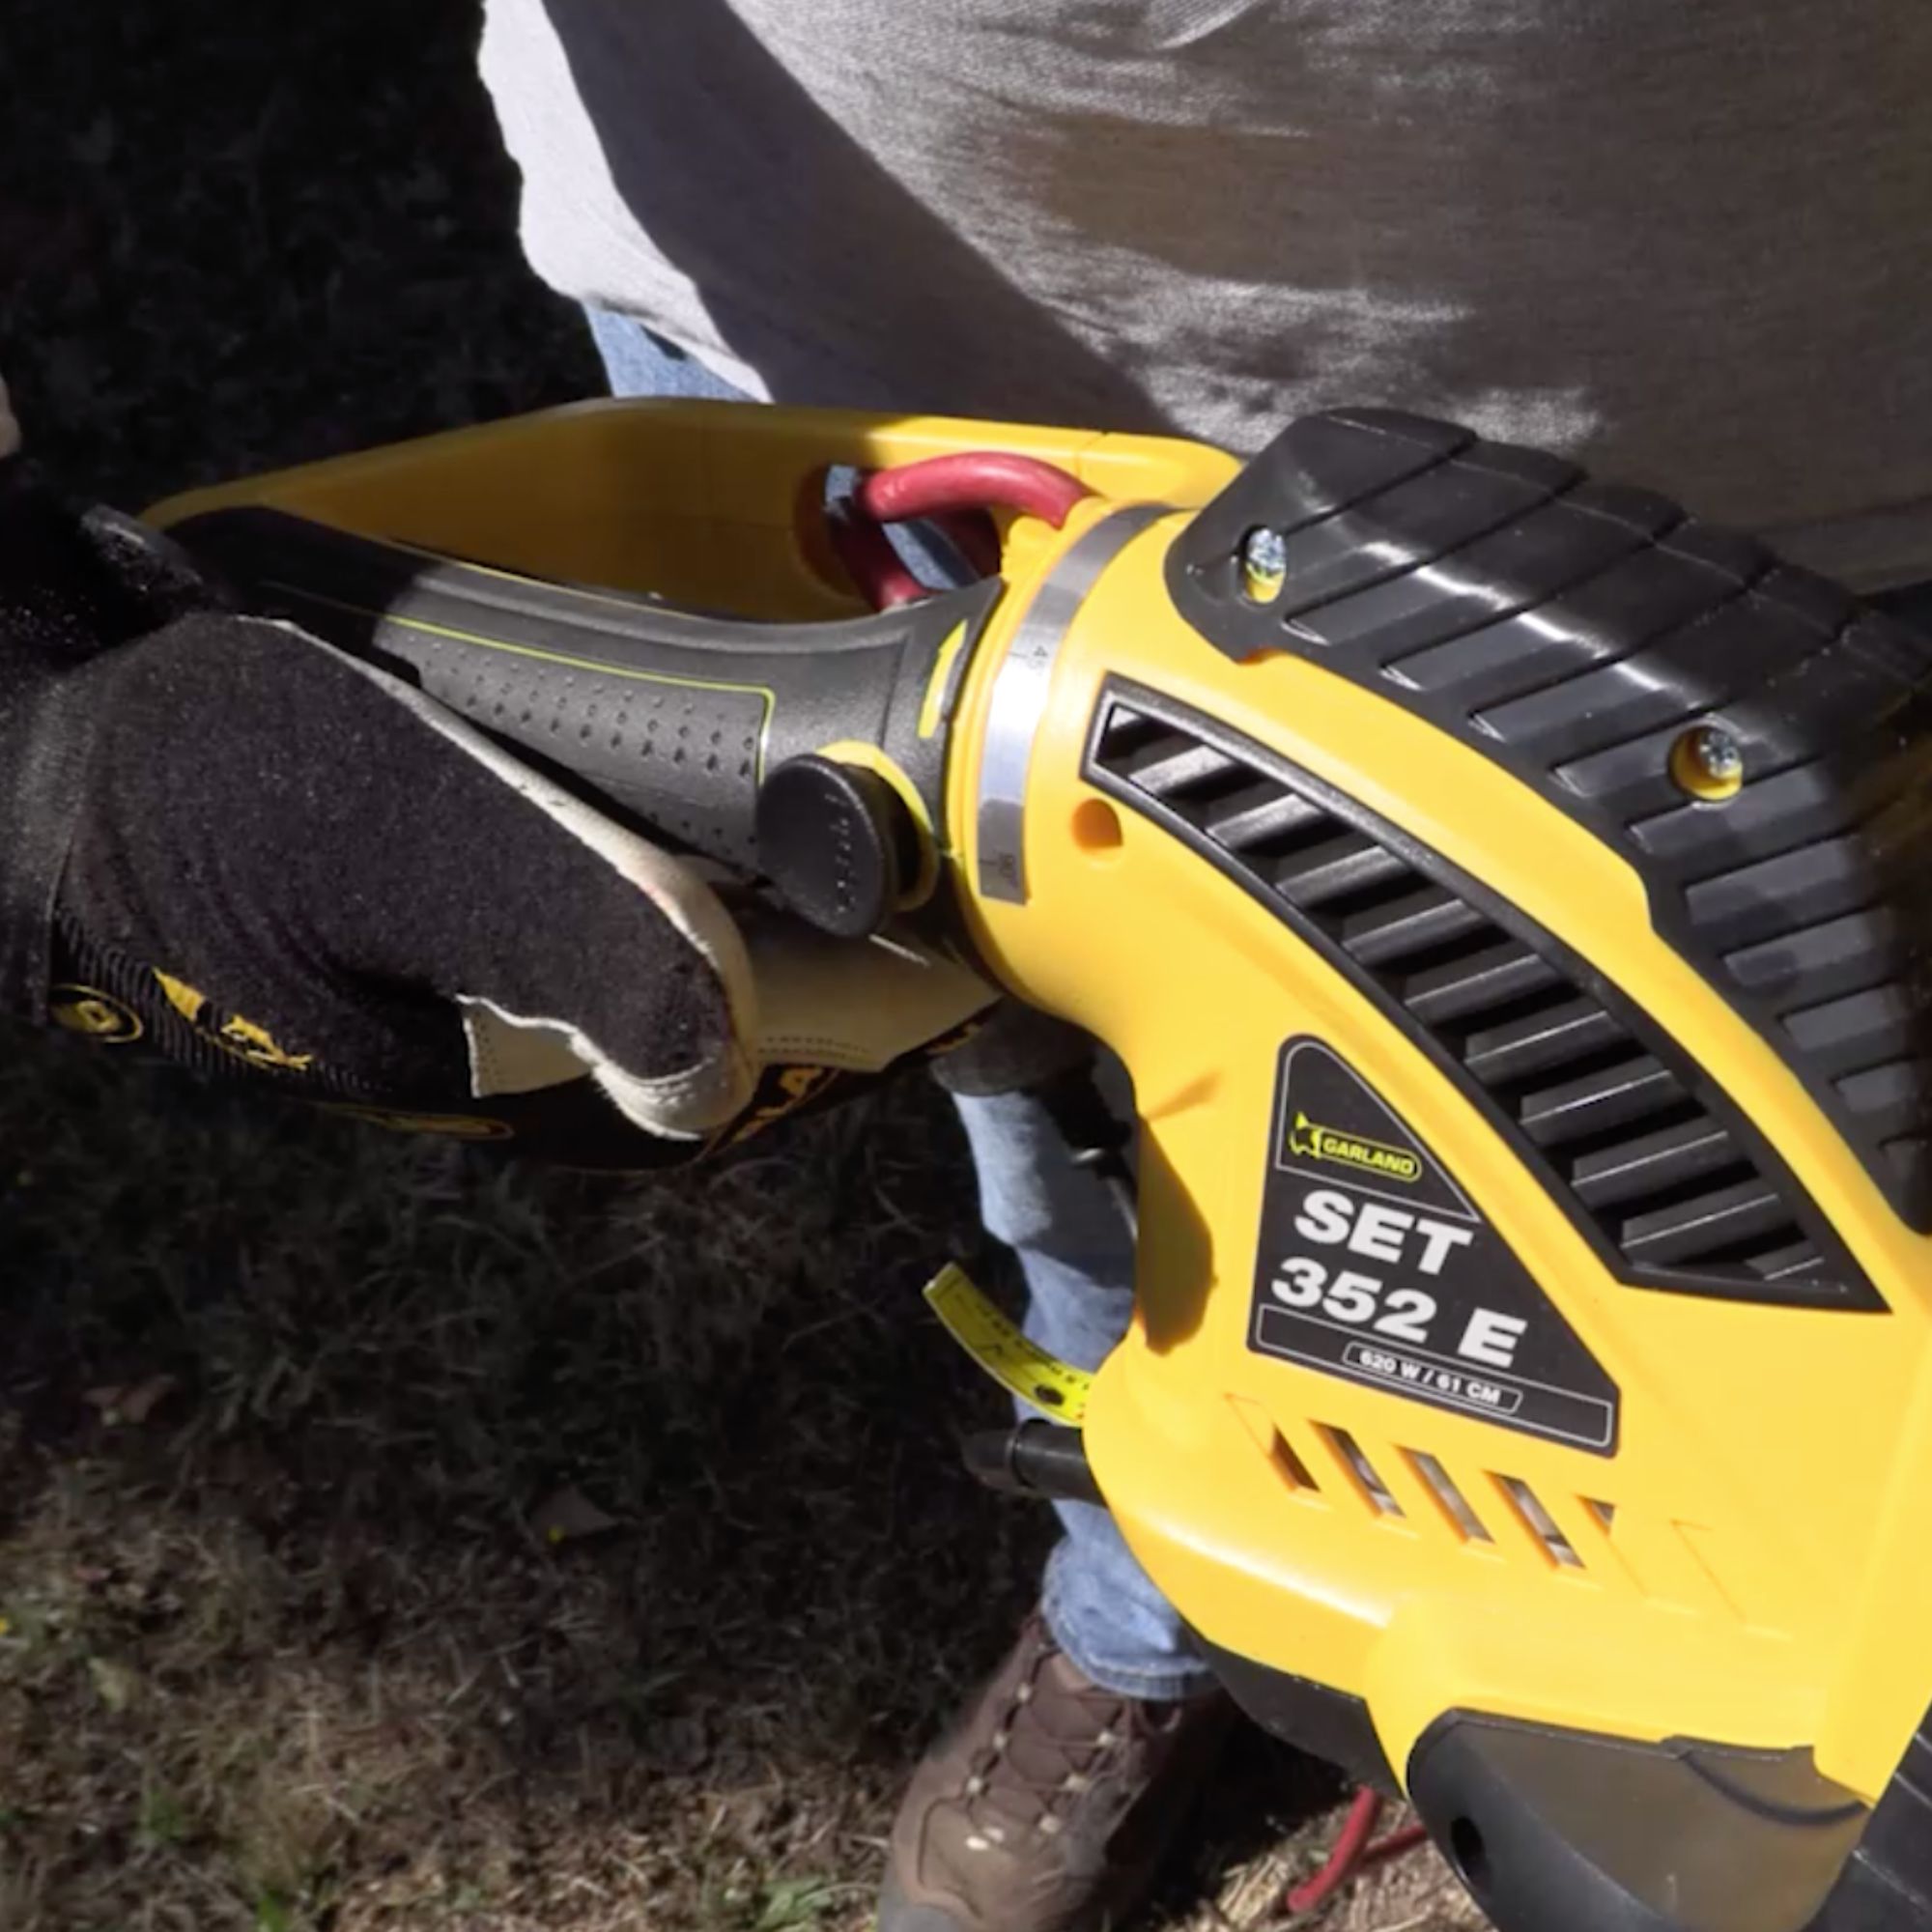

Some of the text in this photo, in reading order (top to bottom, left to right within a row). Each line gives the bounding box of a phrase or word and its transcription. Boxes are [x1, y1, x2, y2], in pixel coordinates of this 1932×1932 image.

[1321, 1137, 1415, 1176] GARLAND
[1294, 1190, 1473, 1274] SET
[1271, 1258, 1528, 1368] 352 E
[1359, 1351, 1397, 1374] 620
[1401, 1362, 1421, 1380] W
[1436, 1375, 1462, 1393] 61
[1466, 1381, 1502, 1405] CM
